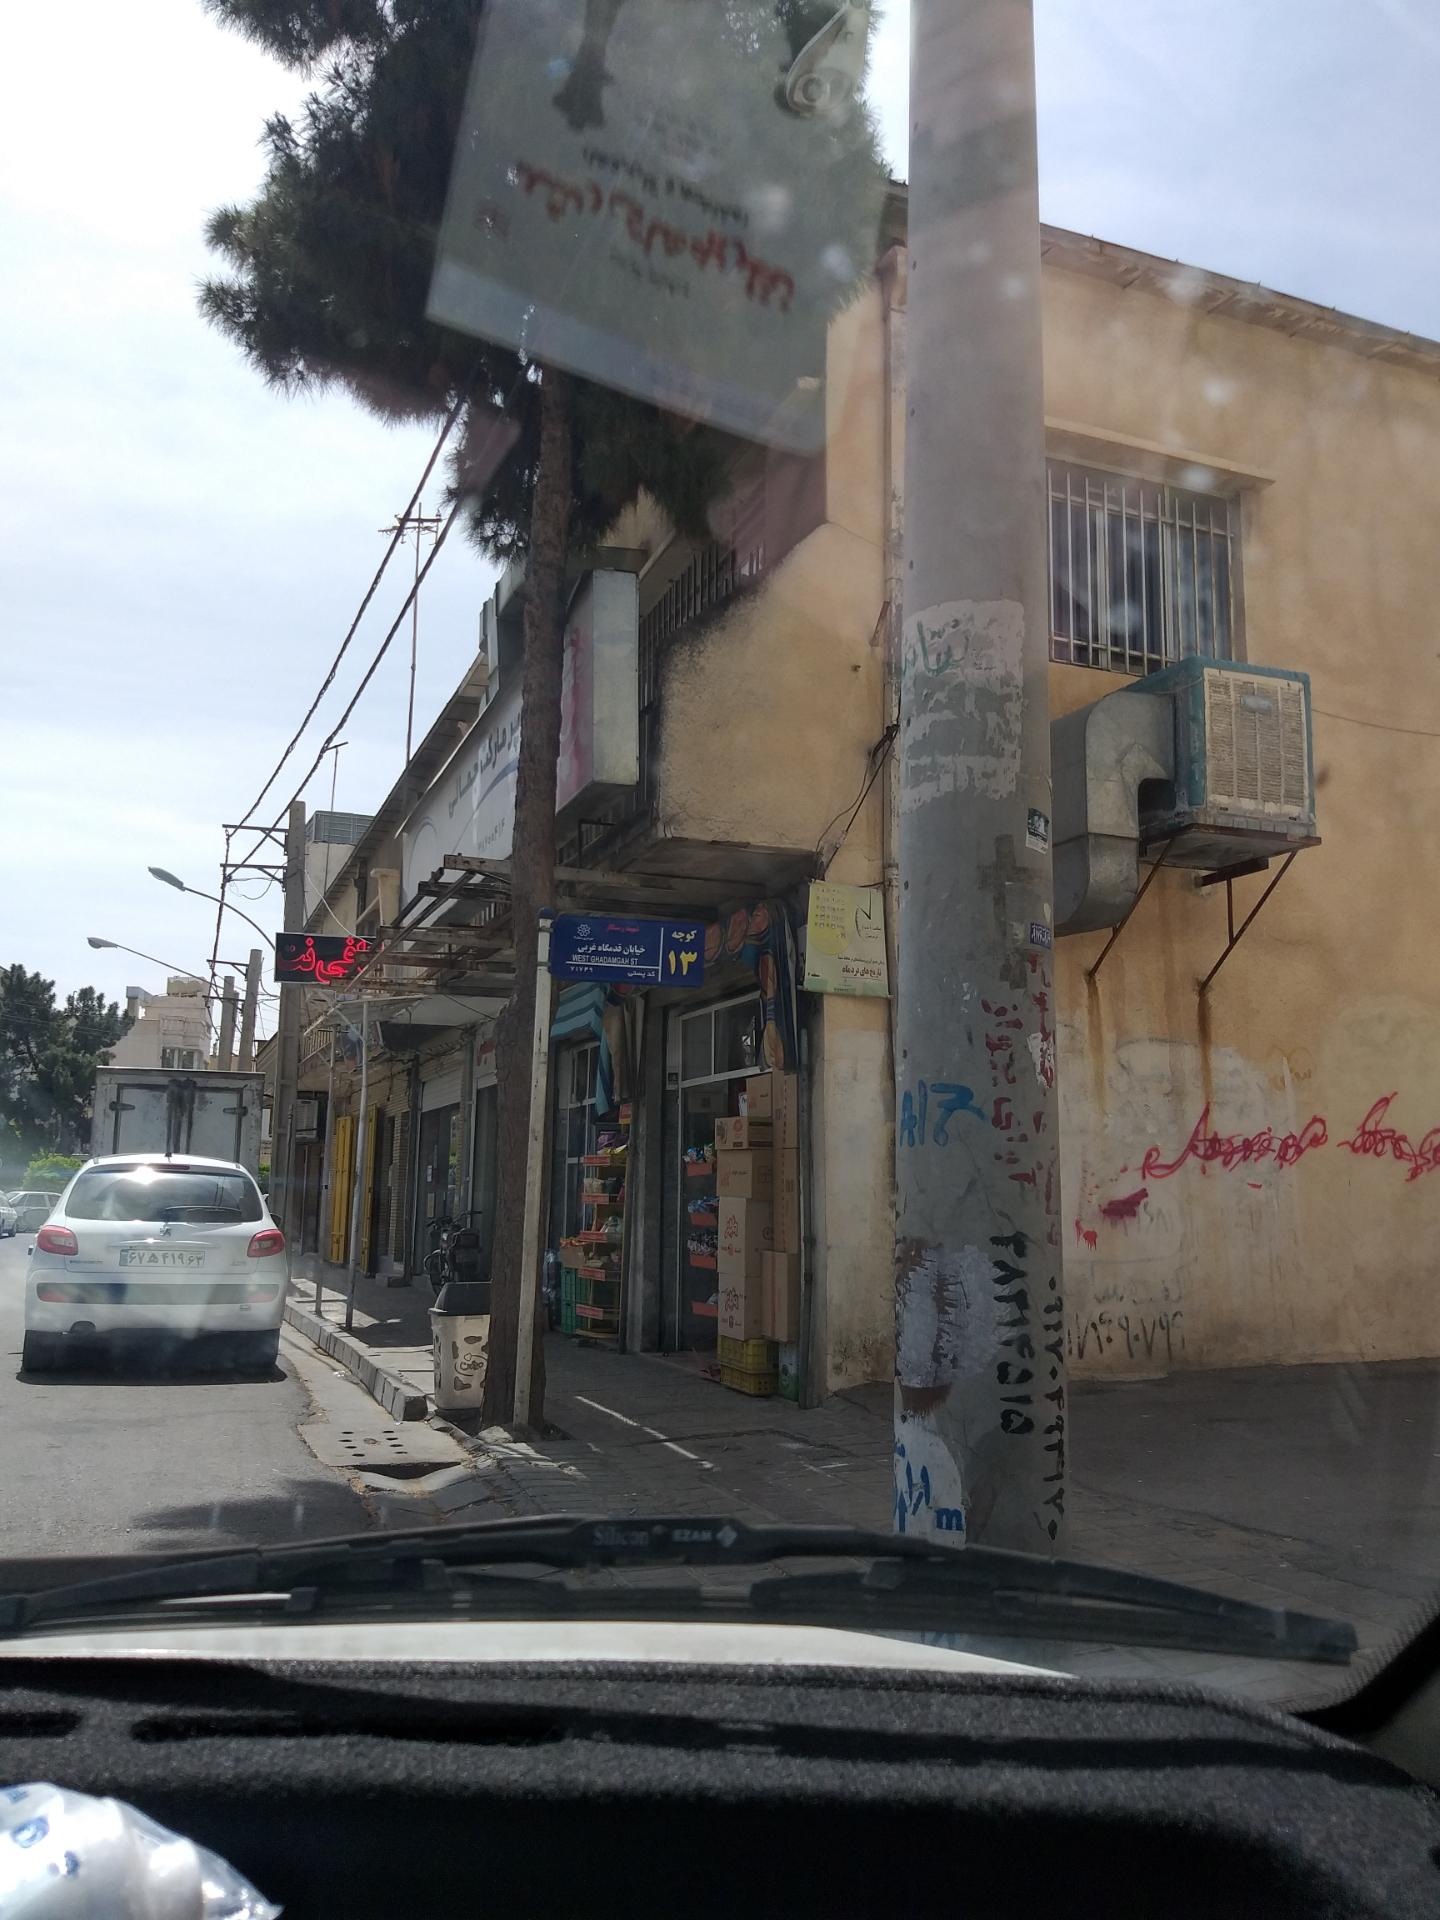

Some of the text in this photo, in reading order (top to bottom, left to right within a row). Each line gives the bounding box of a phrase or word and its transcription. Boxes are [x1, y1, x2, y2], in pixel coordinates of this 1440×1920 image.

[671, 929, 698, 943] کوچه
[577, 942, 646, 956] خیابان قدمگاه غربی
[572, 954, 639, 966] WEST GHADAMGAH ST
[668, 950, 698, 976] ۱۳
